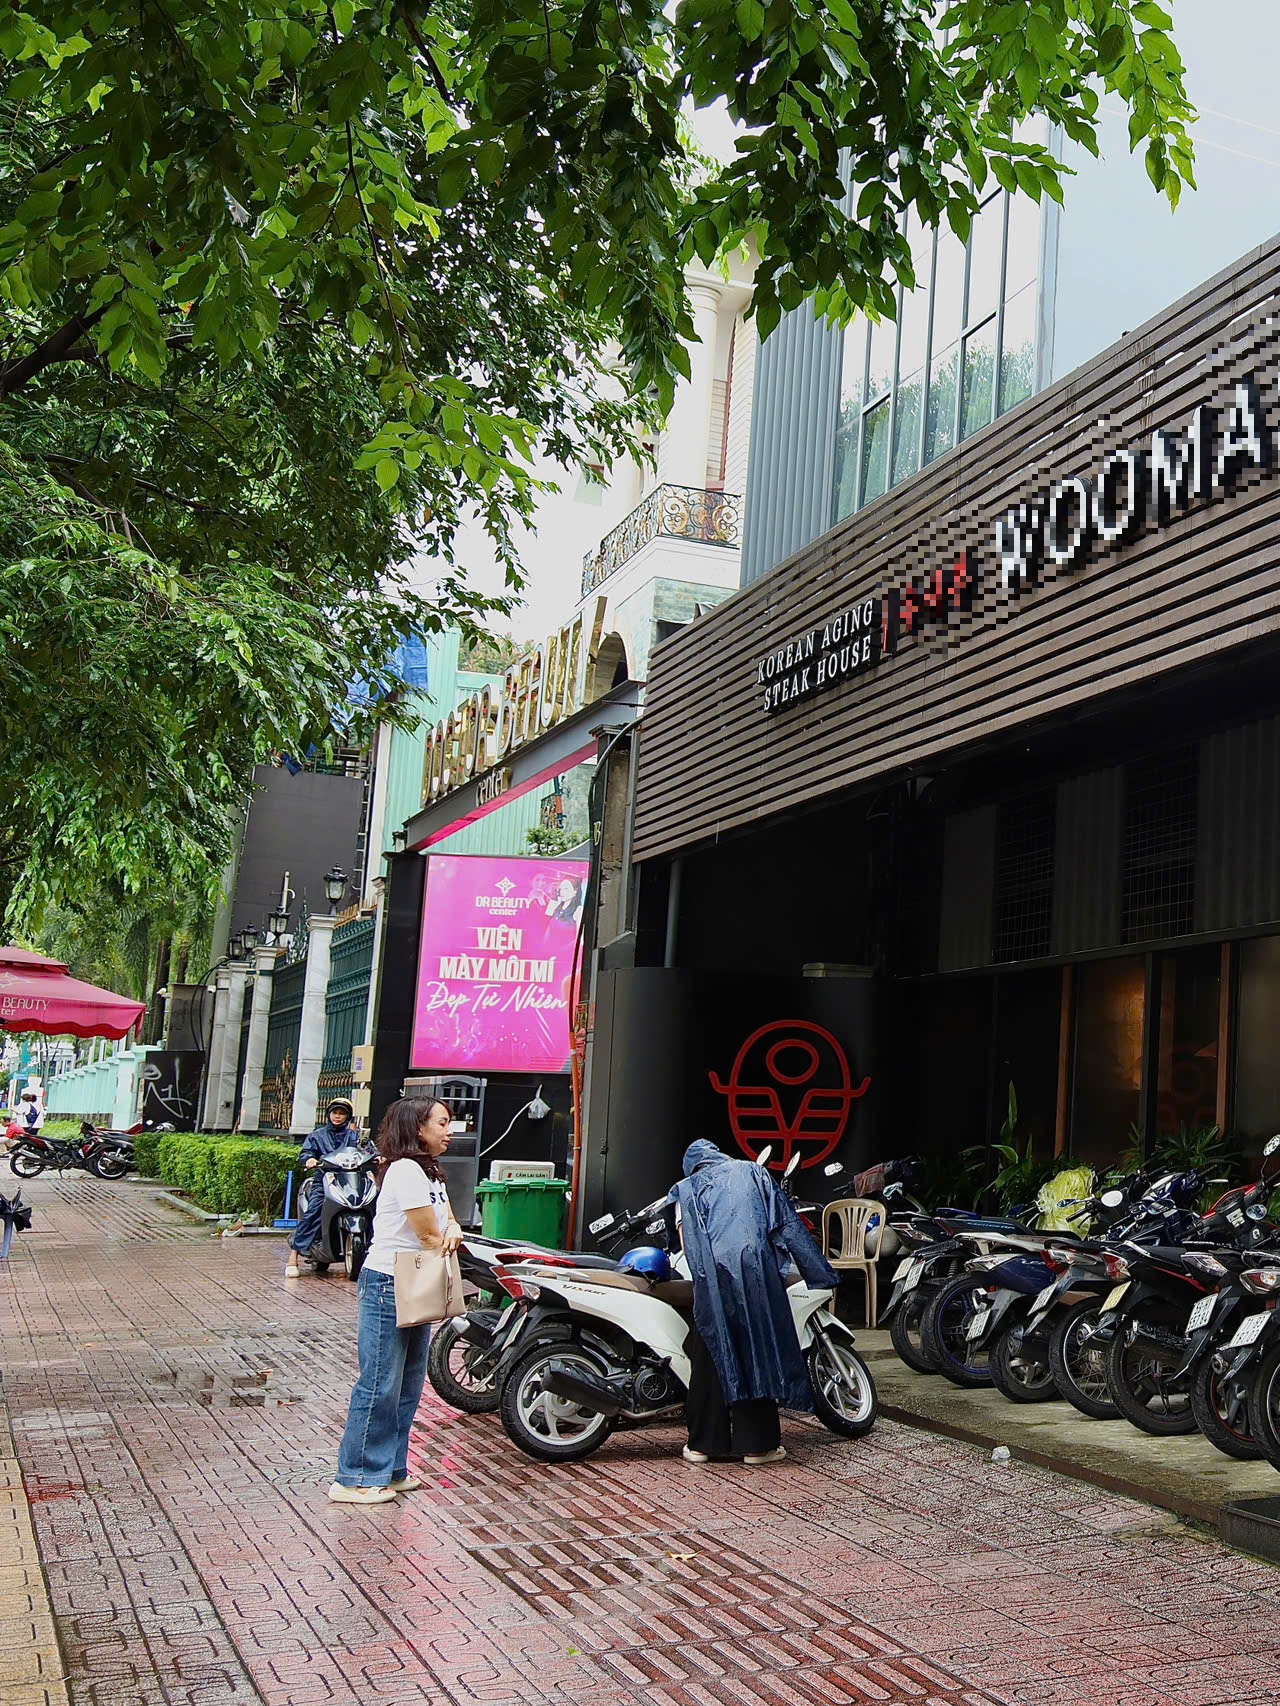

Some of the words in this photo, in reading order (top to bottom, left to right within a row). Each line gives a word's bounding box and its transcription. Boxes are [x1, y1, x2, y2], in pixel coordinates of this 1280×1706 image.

[757, 631, 816, 684] KOREAN
[821, 598, 874, 649] AGING
[763, 666, 810, 712] STEAK
[817, 635, 872, 684] HOUSE
[475, 766, 513, 807] center
[475, 896, 491, 908] DR
[491, 896, 533, 909] BEAUTY
[488, 908, 518, 916] center
[477, 923, 523, 955] VIỆN
[439, 953, 485, 980] MÀY
[488, 955, 526, 982] MÔI
[530, 956, 557, 983] MÍ
[2, 996, 49, 1011] BEAUTY
[501, 983, 569, 1013] Nhiên
